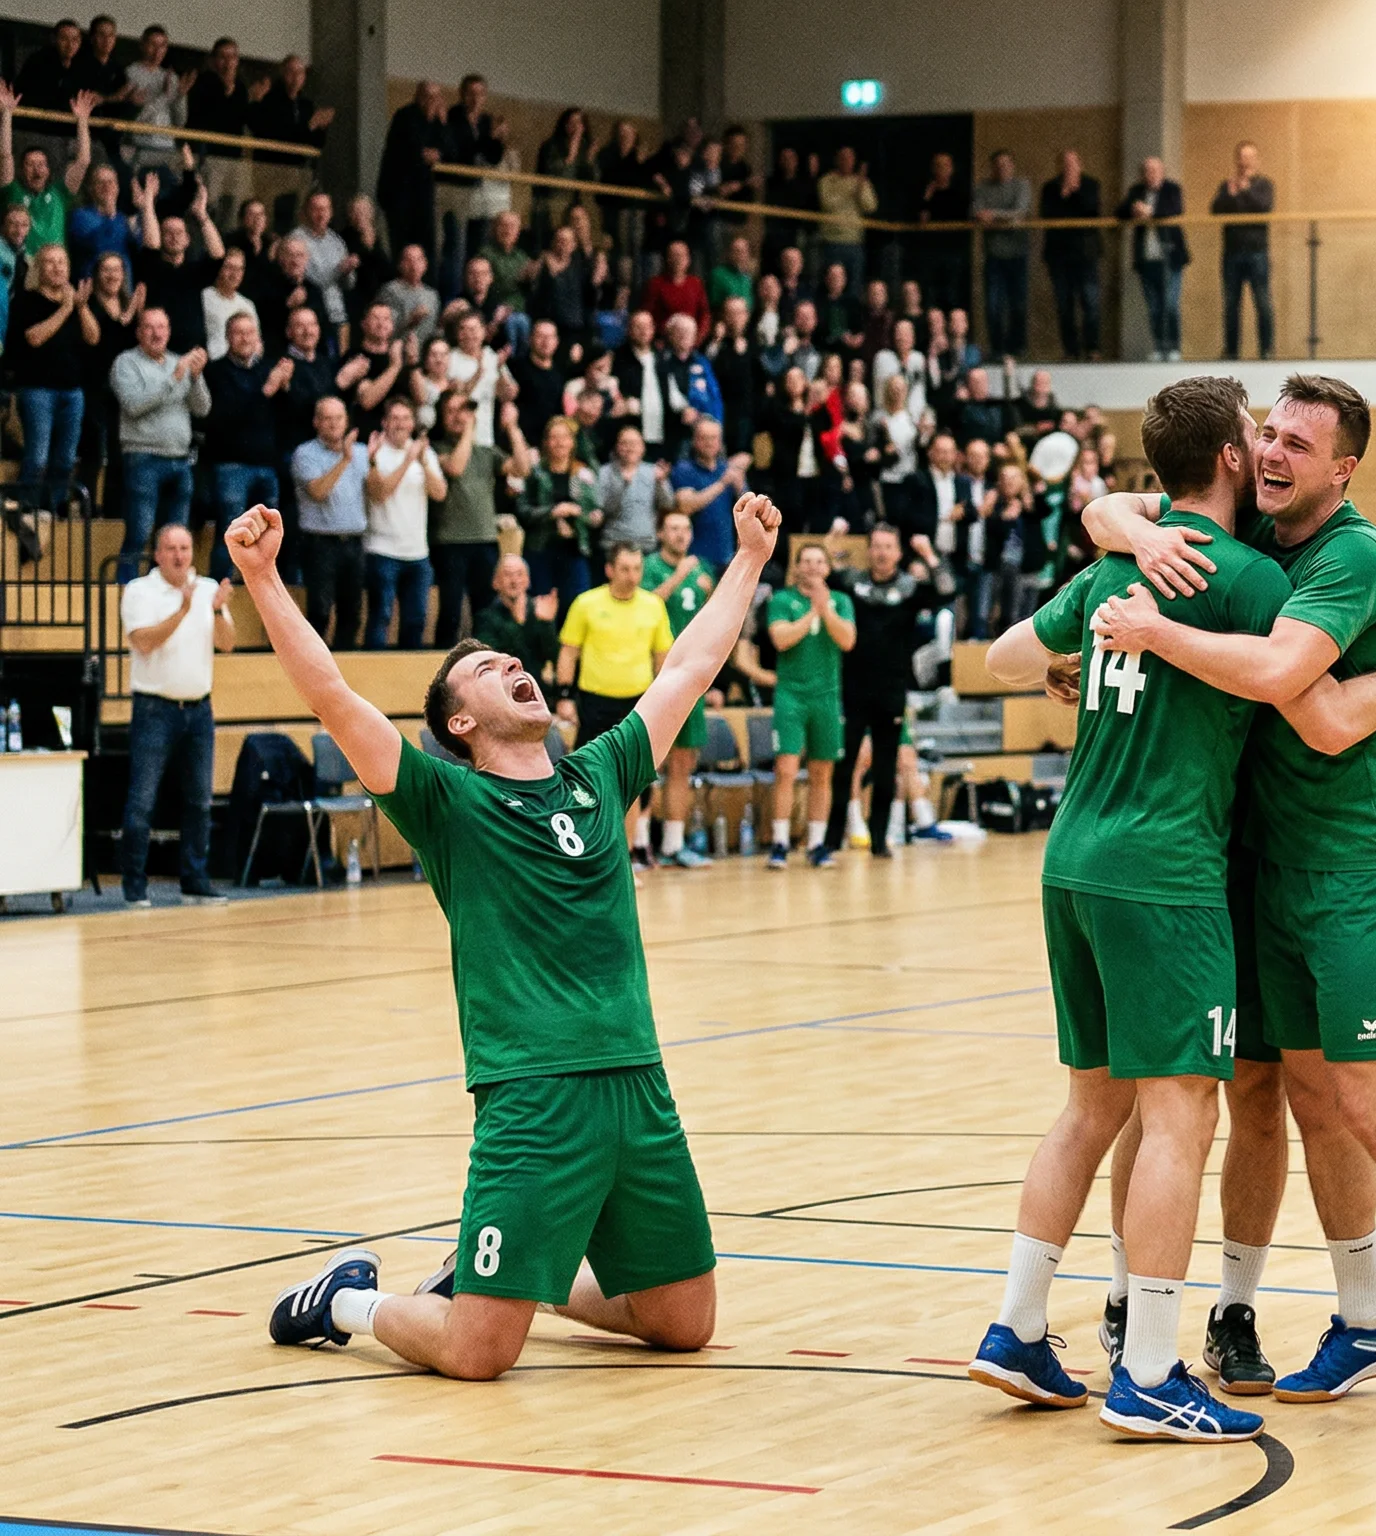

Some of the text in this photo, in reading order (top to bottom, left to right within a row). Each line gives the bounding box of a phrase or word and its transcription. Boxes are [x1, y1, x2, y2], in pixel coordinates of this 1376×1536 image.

[1085, 602, 1147, 714] 14
[550, 812, 585, 857] 8
[1208, 1005, 1237, 1058] 14
[474, 1225, 503, 1277] 8
